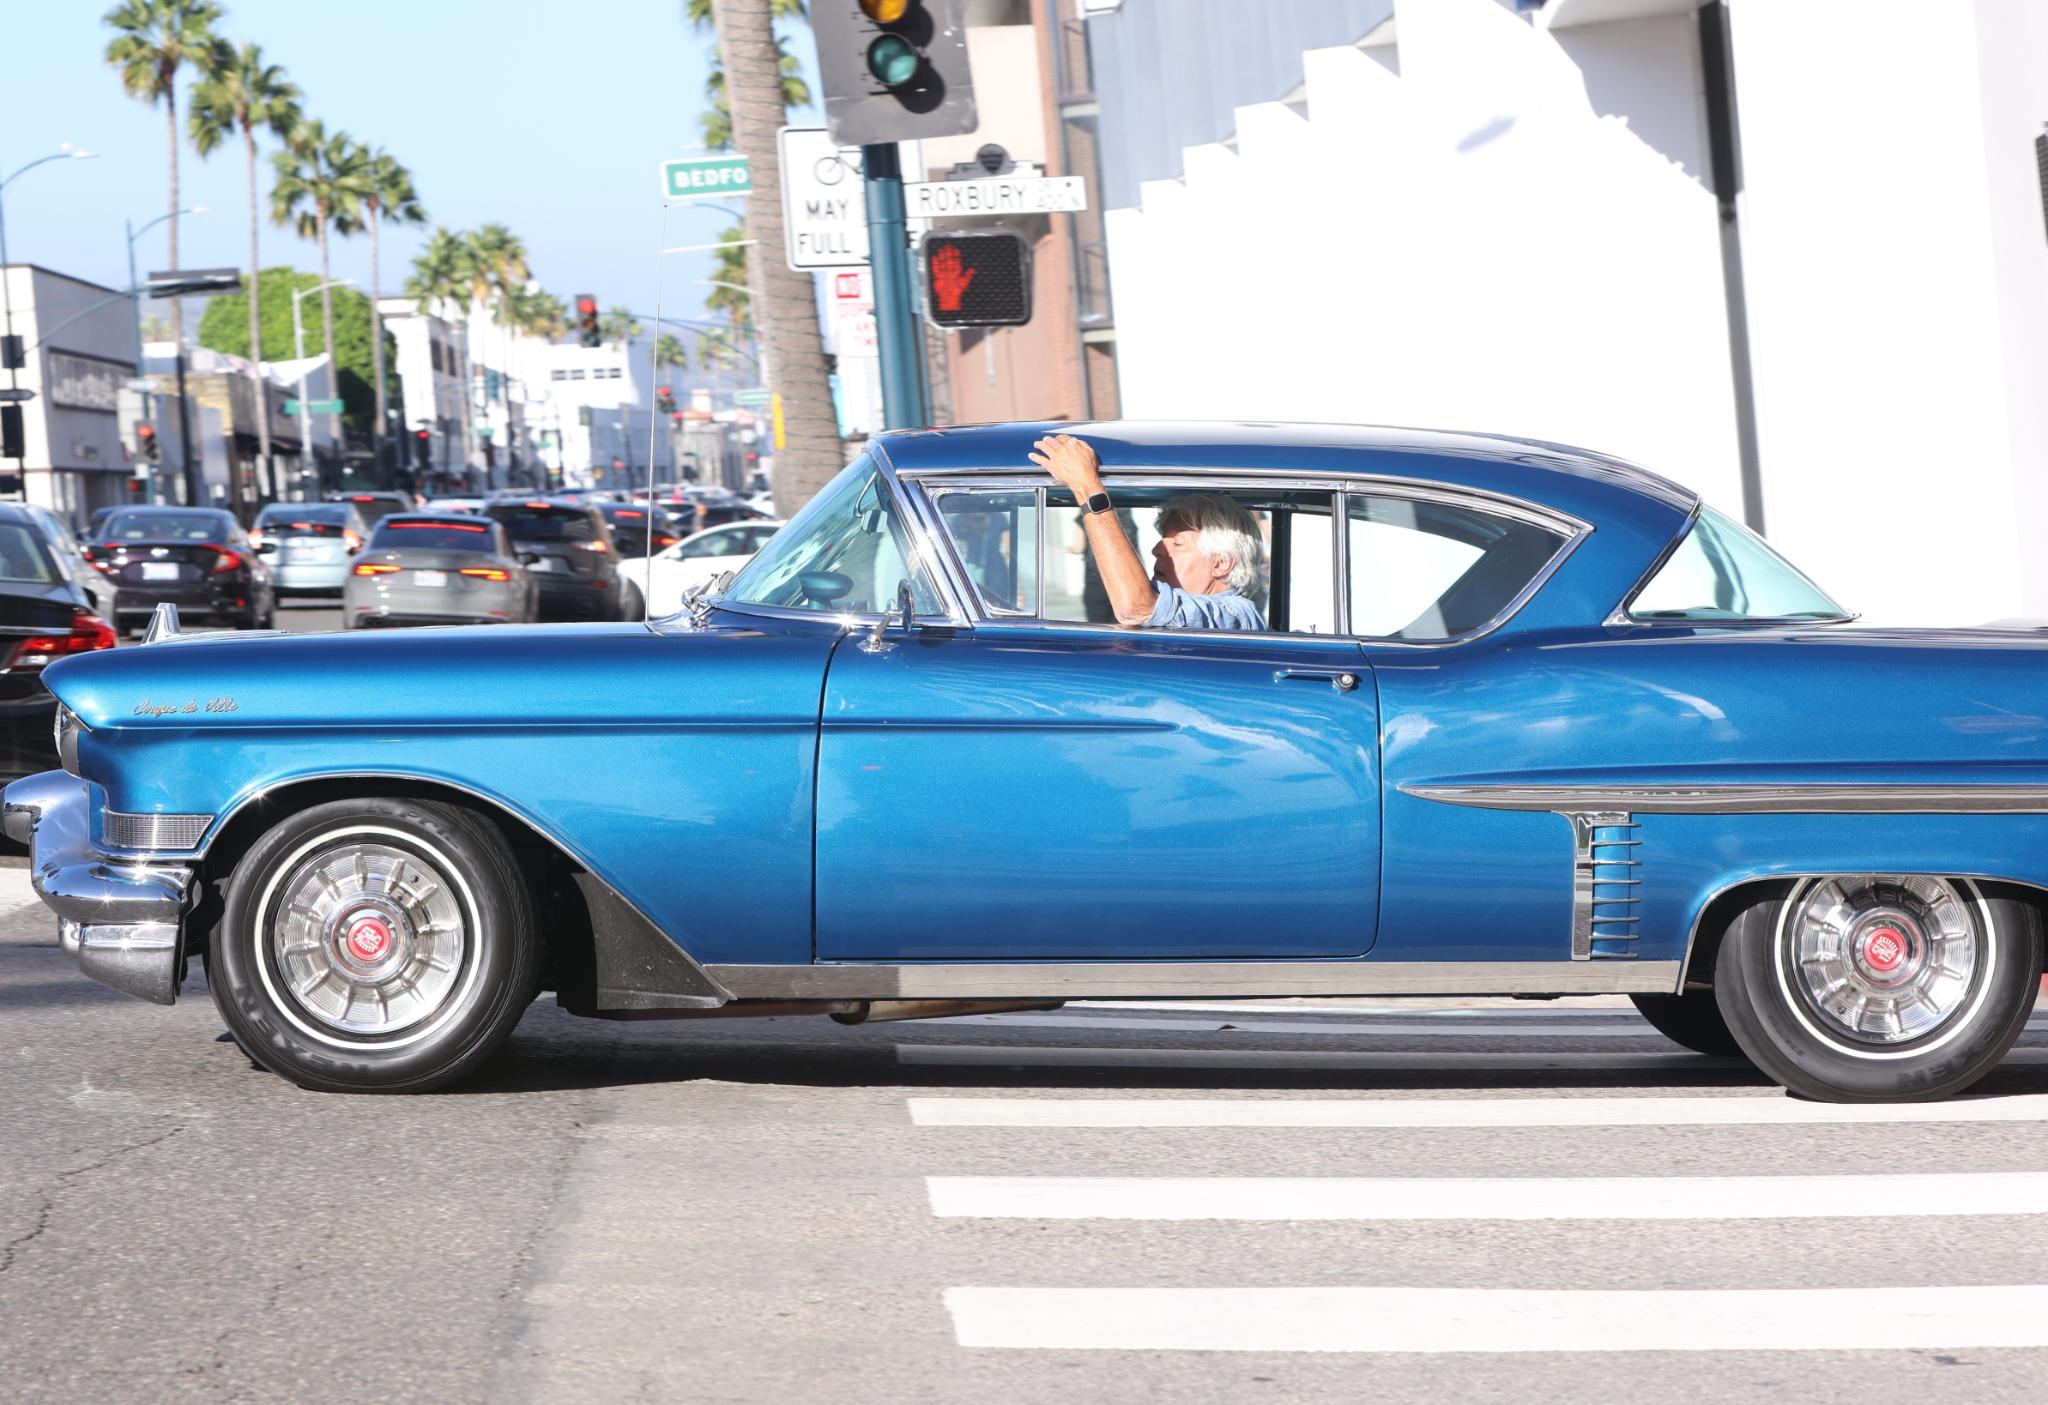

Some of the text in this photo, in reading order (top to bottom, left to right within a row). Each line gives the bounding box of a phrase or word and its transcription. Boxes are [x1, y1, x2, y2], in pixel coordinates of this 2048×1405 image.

[674, 167, 748, 188] BEDFO
[806, 198, 849, 219] MAY
[919, 184, 1027, 212] ROXBURY
[799, 231, 852, 254] FULL
